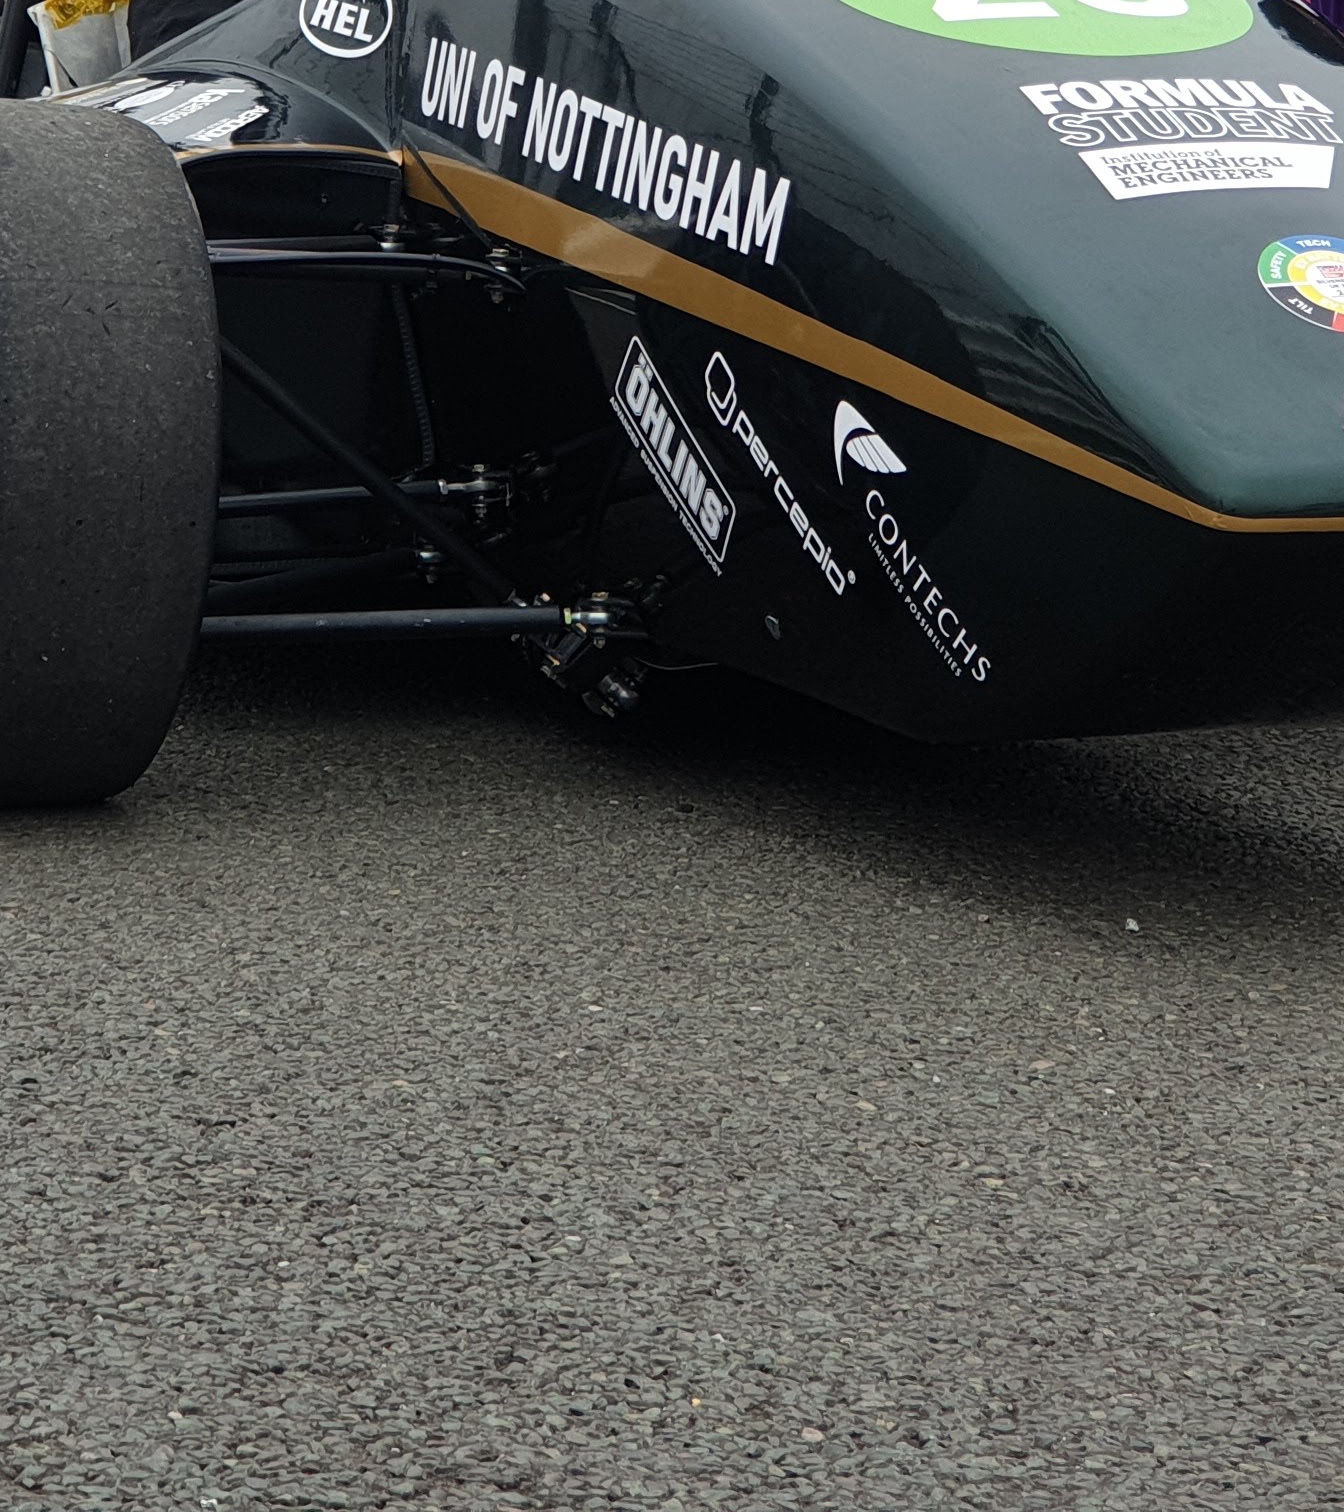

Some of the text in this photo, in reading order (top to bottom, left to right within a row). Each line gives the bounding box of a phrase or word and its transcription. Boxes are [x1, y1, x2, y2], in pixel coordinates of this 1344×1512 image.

[1019, 78, 1335, 115] FORMULA
[1047, 107, 1344, 147] STUDENT
[421, 37, 791, 266] UNI OF NOTTINGHAM
[1100, 148, 1222, 165] Institution of
[1107, 156, 1293, 176] MECHANICAL
[1118, 168, 1273, 188] ENGINEERS
[1296, 239, 1331, 248] TECH
[1270, 251, 1287, 280] SAFETY
[1287, 297, 1314, 315] TILT
[609, 396, 722, 577] ADVANCED SUSPENSION TECHNOLOGY
[865, 489, 991, 681] CONTECHS
[868, 533, 962, 677] LIMITLESS POSSIBILITIES
